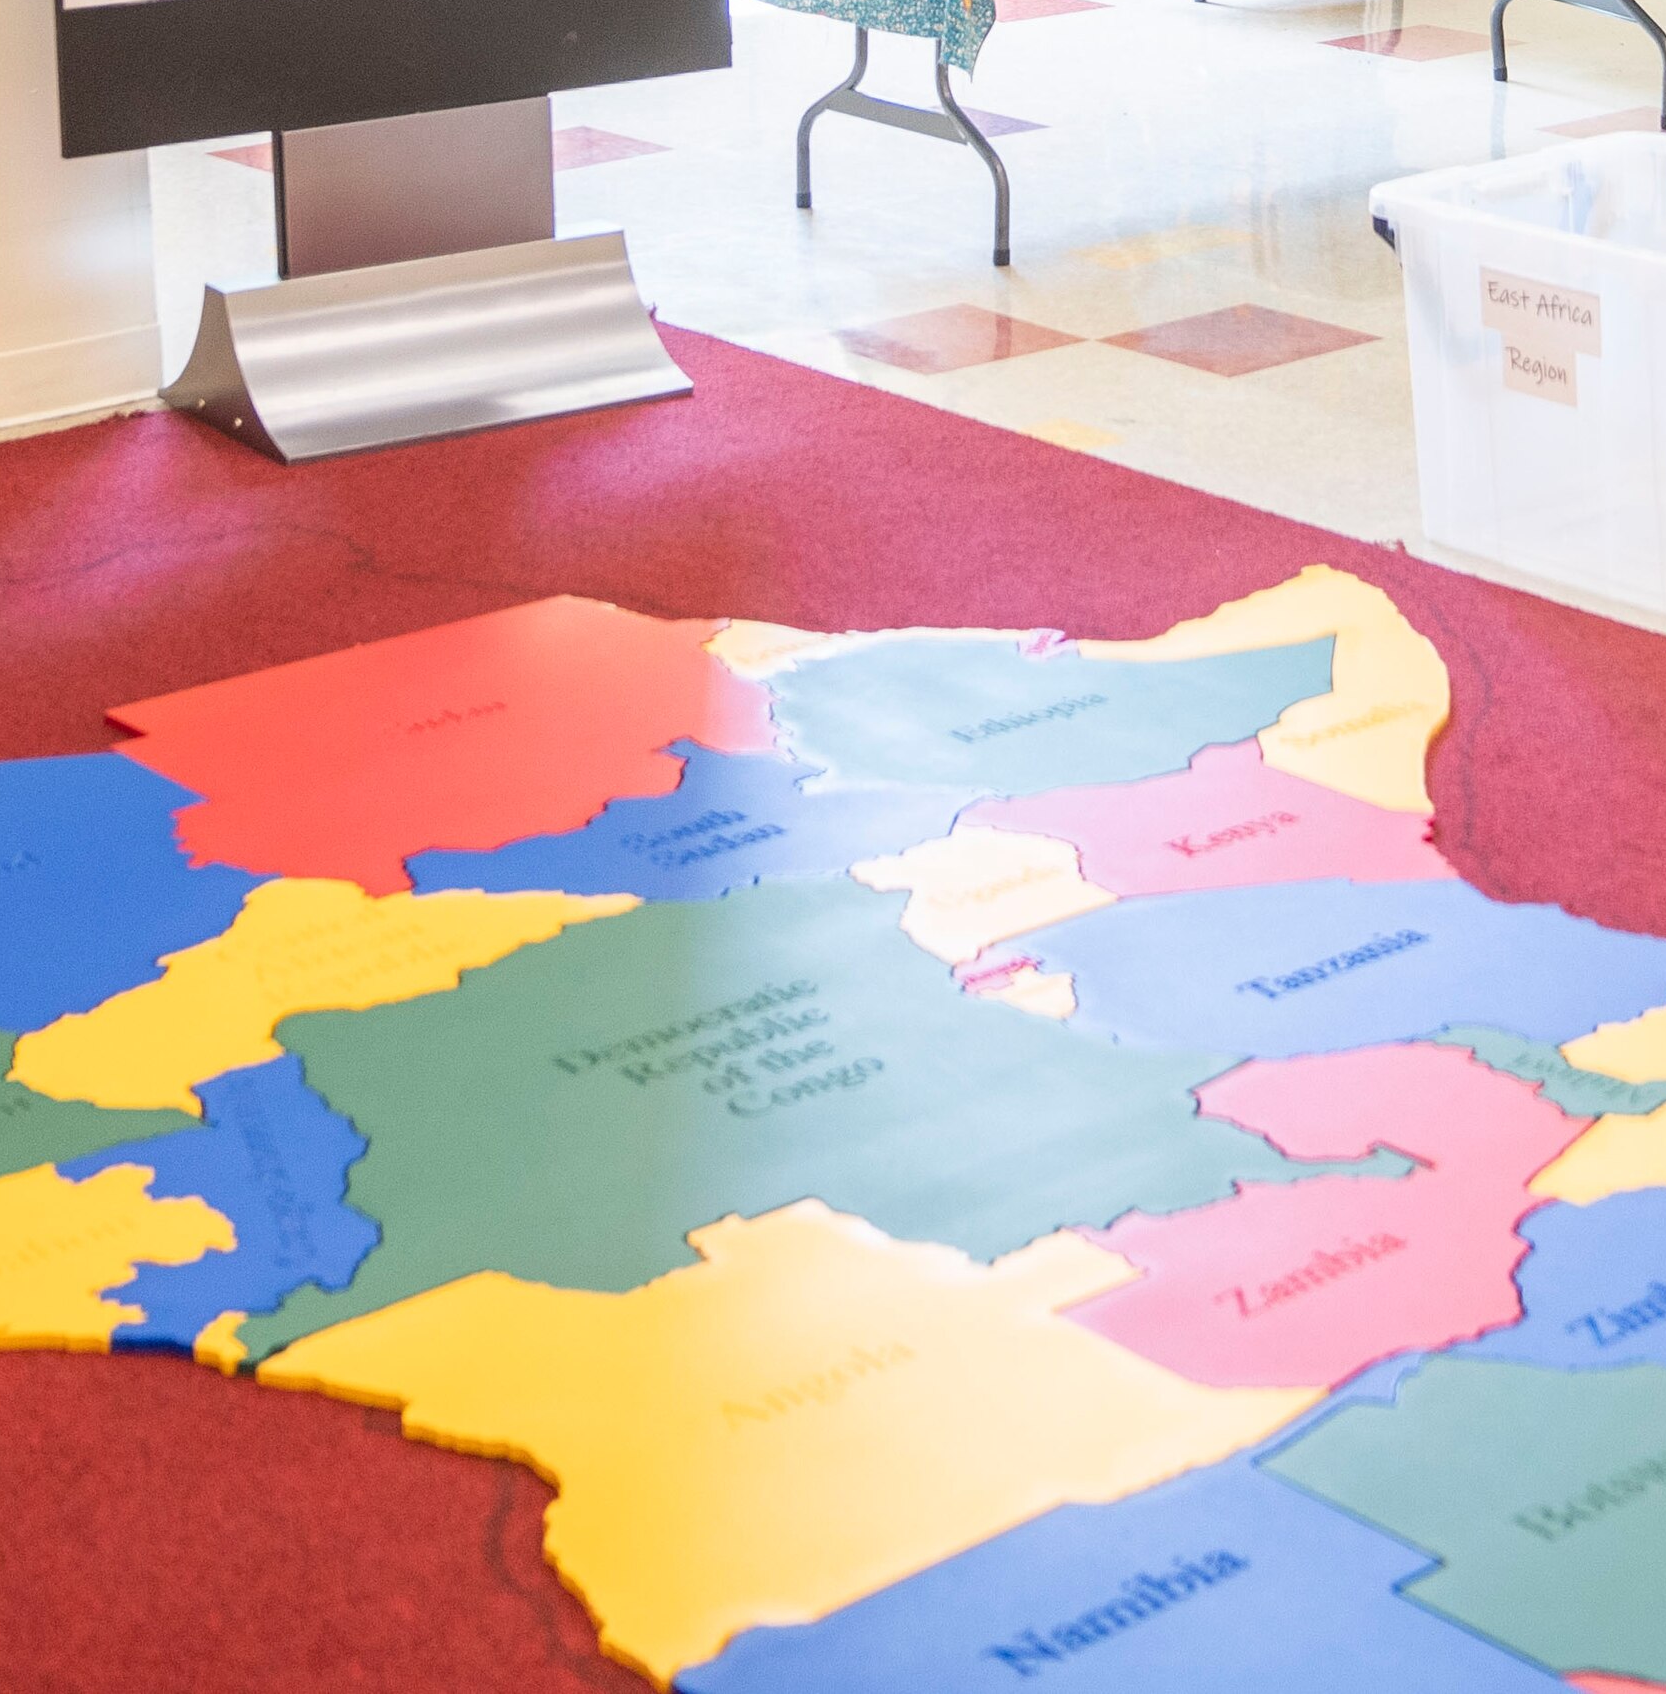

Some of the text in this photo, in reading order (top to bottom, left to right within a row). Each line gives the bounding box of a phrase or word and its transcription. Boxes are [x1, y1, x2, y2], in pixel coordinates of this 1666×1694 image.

[1487, 280, 1593, 326] East Africa
[1505, 346, 1567, 385] Region
[948, 692, 1110, 744] Ethiopia
[1162, 810, 1300, 857] Kenya
[1235, 928, 1429, 999] Tanzania
[552, 978, 819, 1075] Democratic
[620, 1007, 831, 1088] Republic
[701, 1039, 836, 1096] of the
[726, 1056, 884, 1120] Congo
[1213, 1232, 1407, 1320] Zambia
[981, 1549, 1250, 1677] Namibia
